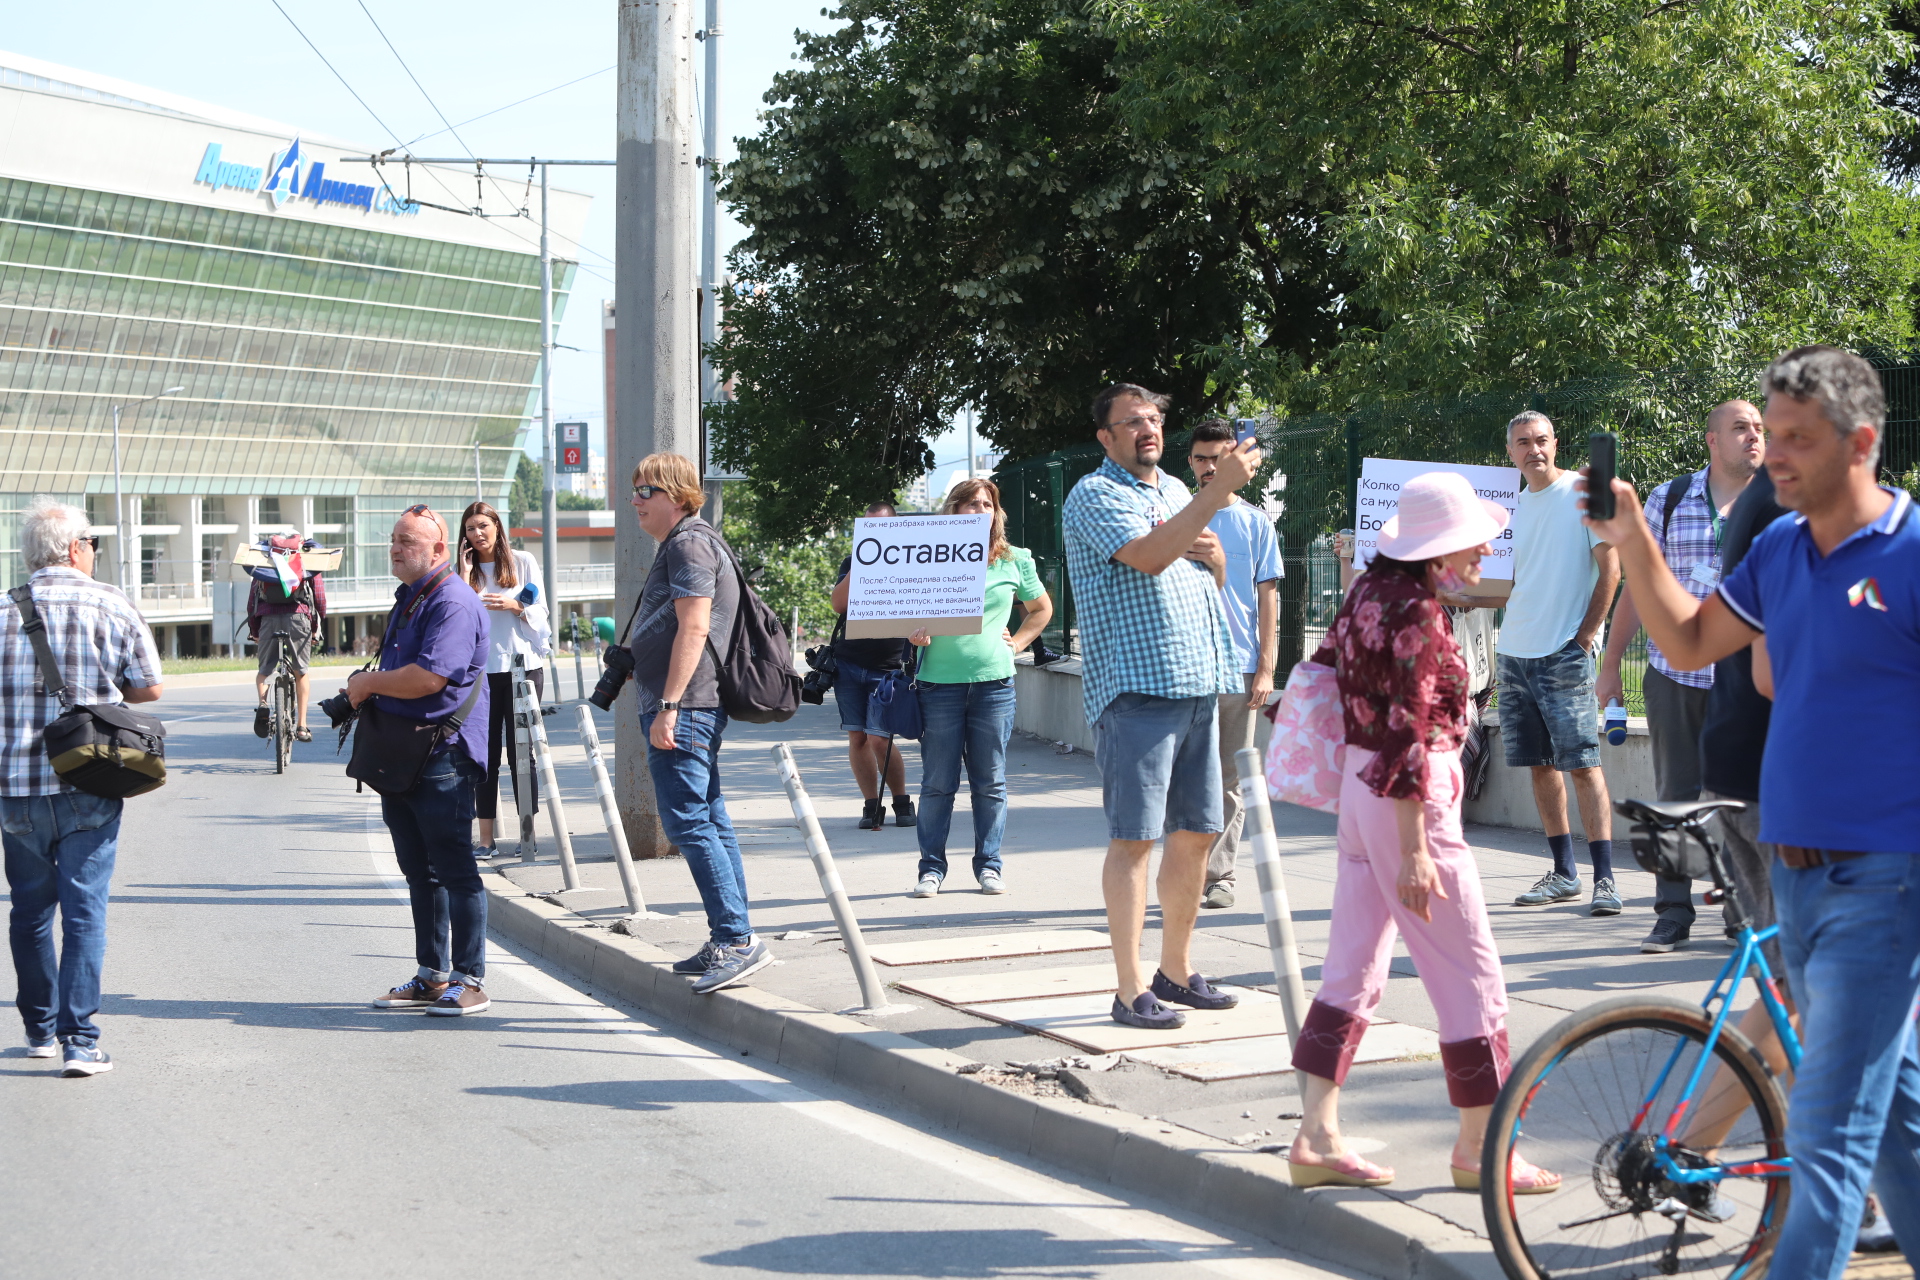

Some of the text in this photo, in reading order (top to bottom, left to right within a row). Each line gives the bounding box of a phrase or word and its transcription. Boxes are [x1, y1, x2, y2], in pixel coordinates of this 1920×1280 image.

[196, 142, 264, 190] Арена
[301, 162, 376, 213] Армеец
[1362, 478, 1400, 492] Колко
[1360, 497, 1399, 510] са нуж
[863, 520, 877, 528] Как
[889, 519, 925, 529] разбраха
[949, 516, 981, 526] искаме?
[1357, 539, 1377, 548] поз
[856, 537, 984, 566] Оставка
[859, 573, 976, 585] После? Справедлива съдебна
[863, 588, 897, 596] система,
[920, 587, 932, 595] да
[942, 586, 969, 594] осъди.
[408, 594, 425, 614] Canon
[849, 598, 860, 606] Не
[905, 598, 933, 606] отпуск,
[945, 596, 983, 605] ваканция.
[849, 609, 856, 617] А
[857, 610, 874, 619] чуха
[950, 605, 981, 615] стачки?
